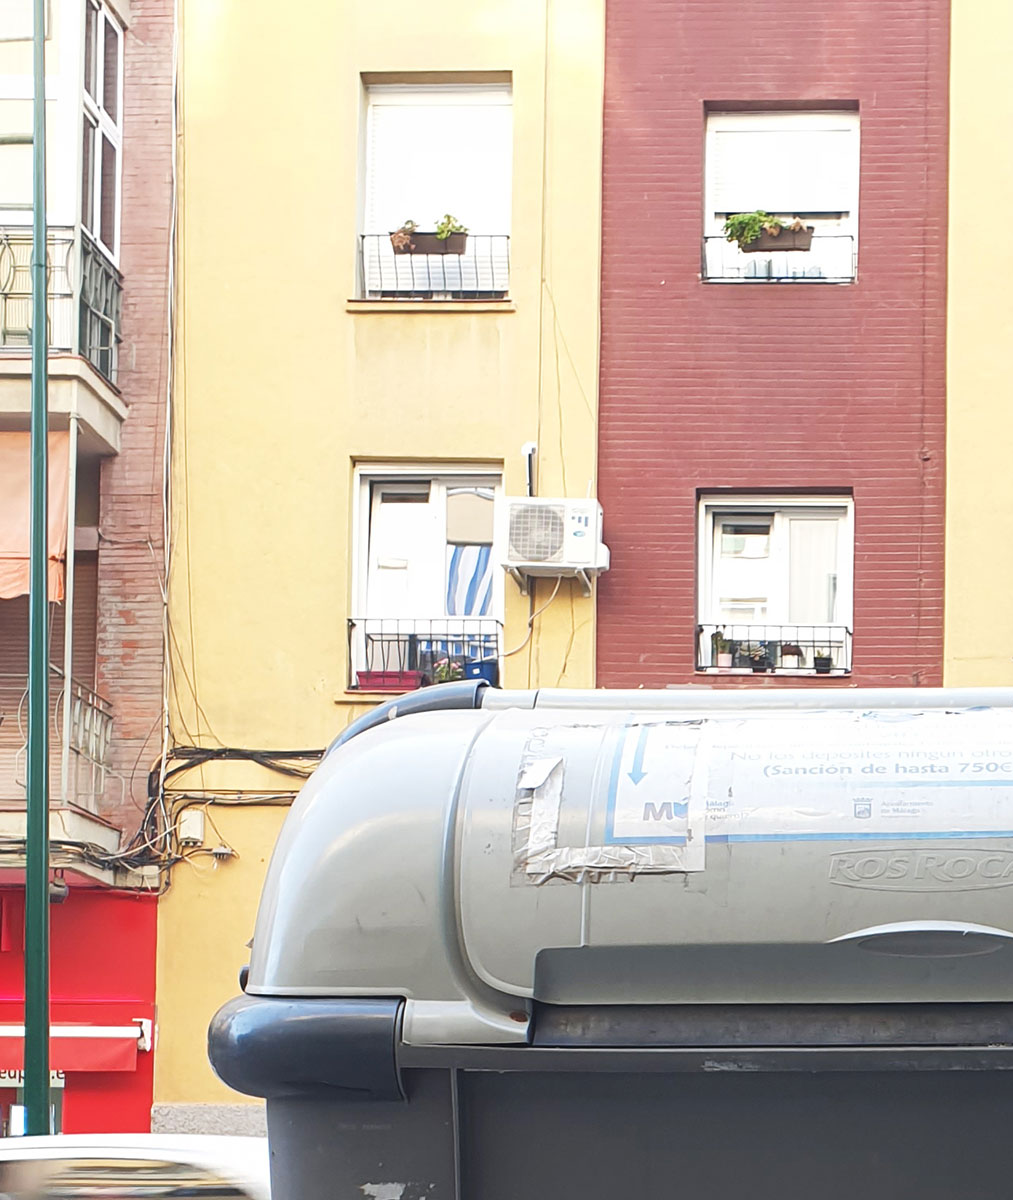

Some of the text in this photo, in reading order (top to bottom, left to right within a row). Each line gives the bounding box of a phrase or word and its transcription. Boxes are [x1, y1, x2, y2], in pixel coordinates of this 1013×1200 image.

[762, 763, 853, 778] (Sanción
[860, 763, 888, 775] de
[895, 762, 950, 774] hasta
